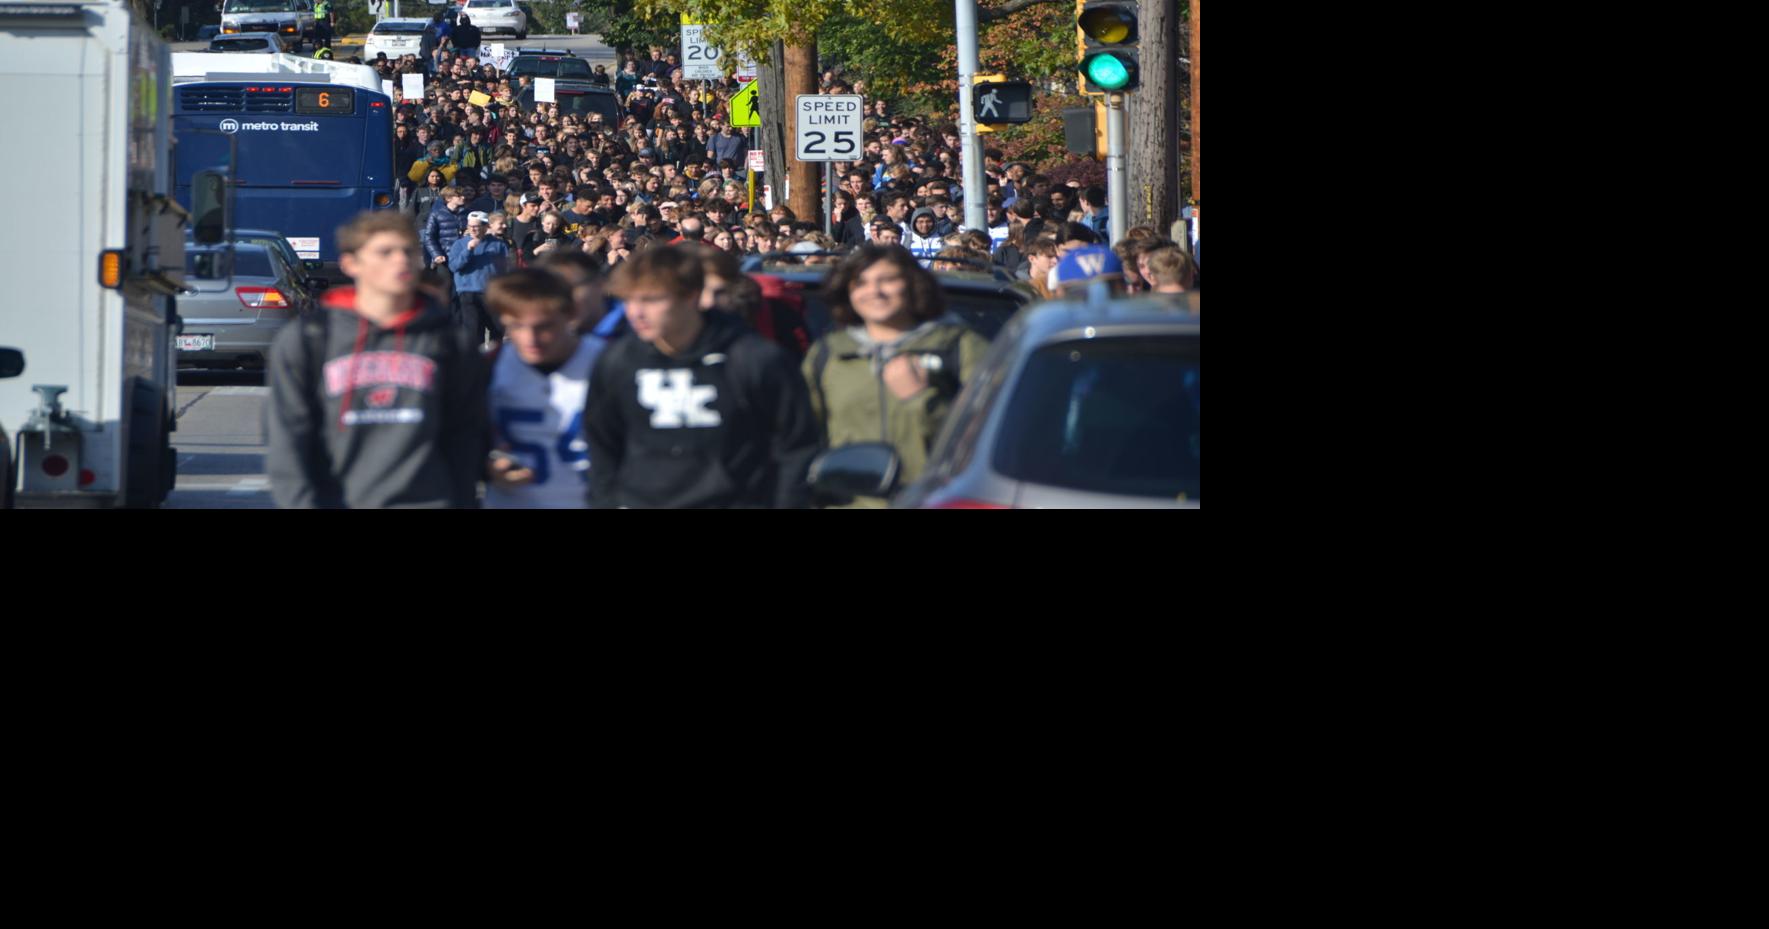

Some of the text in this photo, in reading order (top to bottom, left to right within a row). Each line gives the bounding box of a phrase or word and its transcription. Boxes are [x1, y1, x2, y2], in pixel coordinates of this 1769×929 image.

[687, 45, 719, 60] 20
[318, 92, 330, 108] 6
[803, 101, 857, 112] SPEED
[242, 121, 279, 131] metro
[280, 120, 319, 132] transit
[809, 114, 850, 125] LIMIT
[803, 131, 856, 154] 25
[1075, 253, 1105, 276] W
[635, 368, 722, 429] UK
